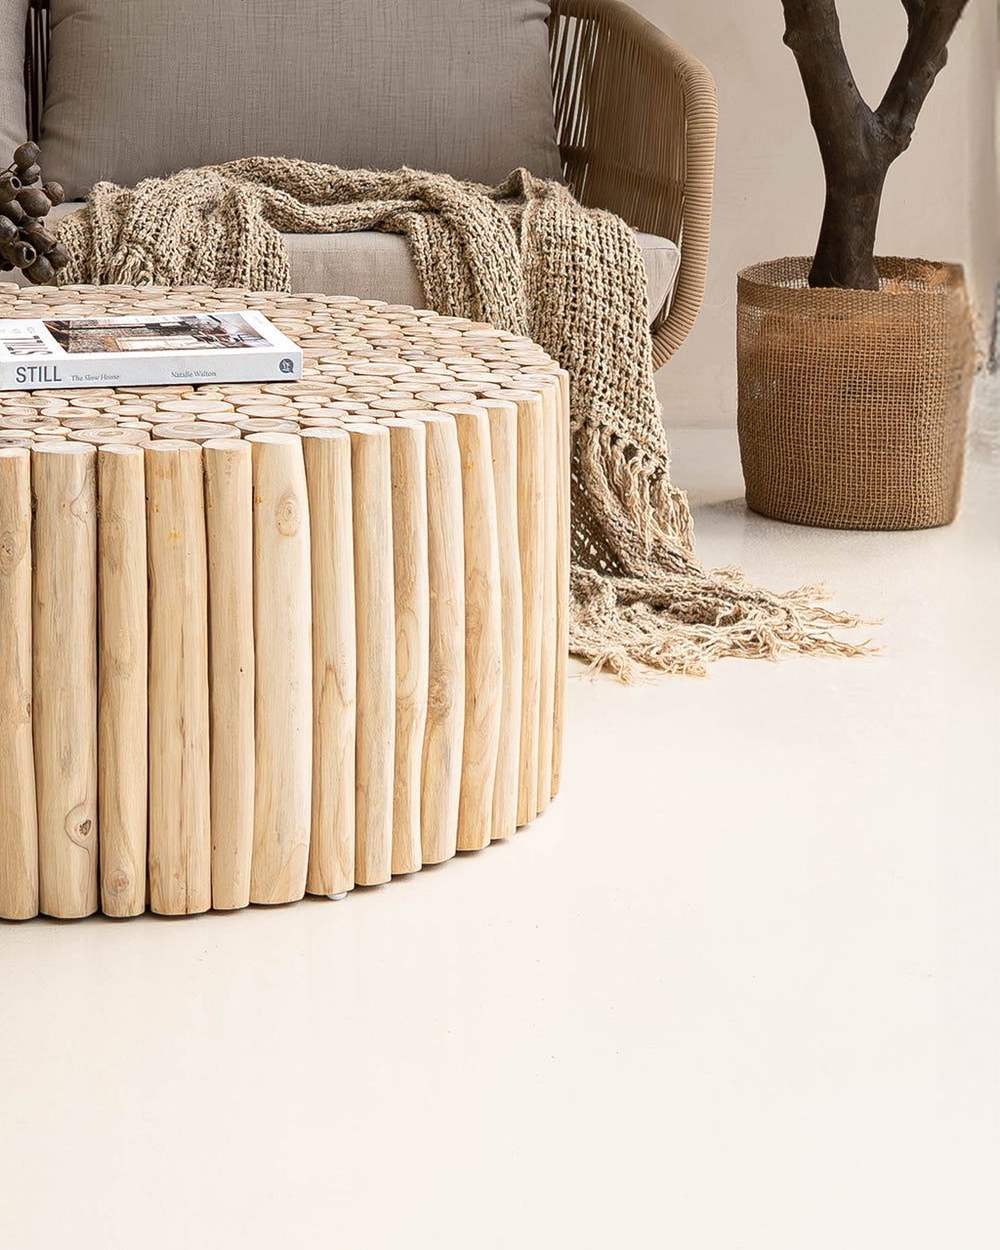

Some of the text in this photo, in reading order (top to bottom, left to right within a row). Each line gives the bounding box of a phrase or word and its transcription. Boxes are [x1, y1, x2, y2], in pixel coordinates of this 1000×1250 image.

[0, 335, 53, 356] STILL
[15, 366, 62, 383] STILL
[71, 374, 83, 382] The
[171, 370, 193, 378] Natalie
[193, 369, 217, 377] Walton
